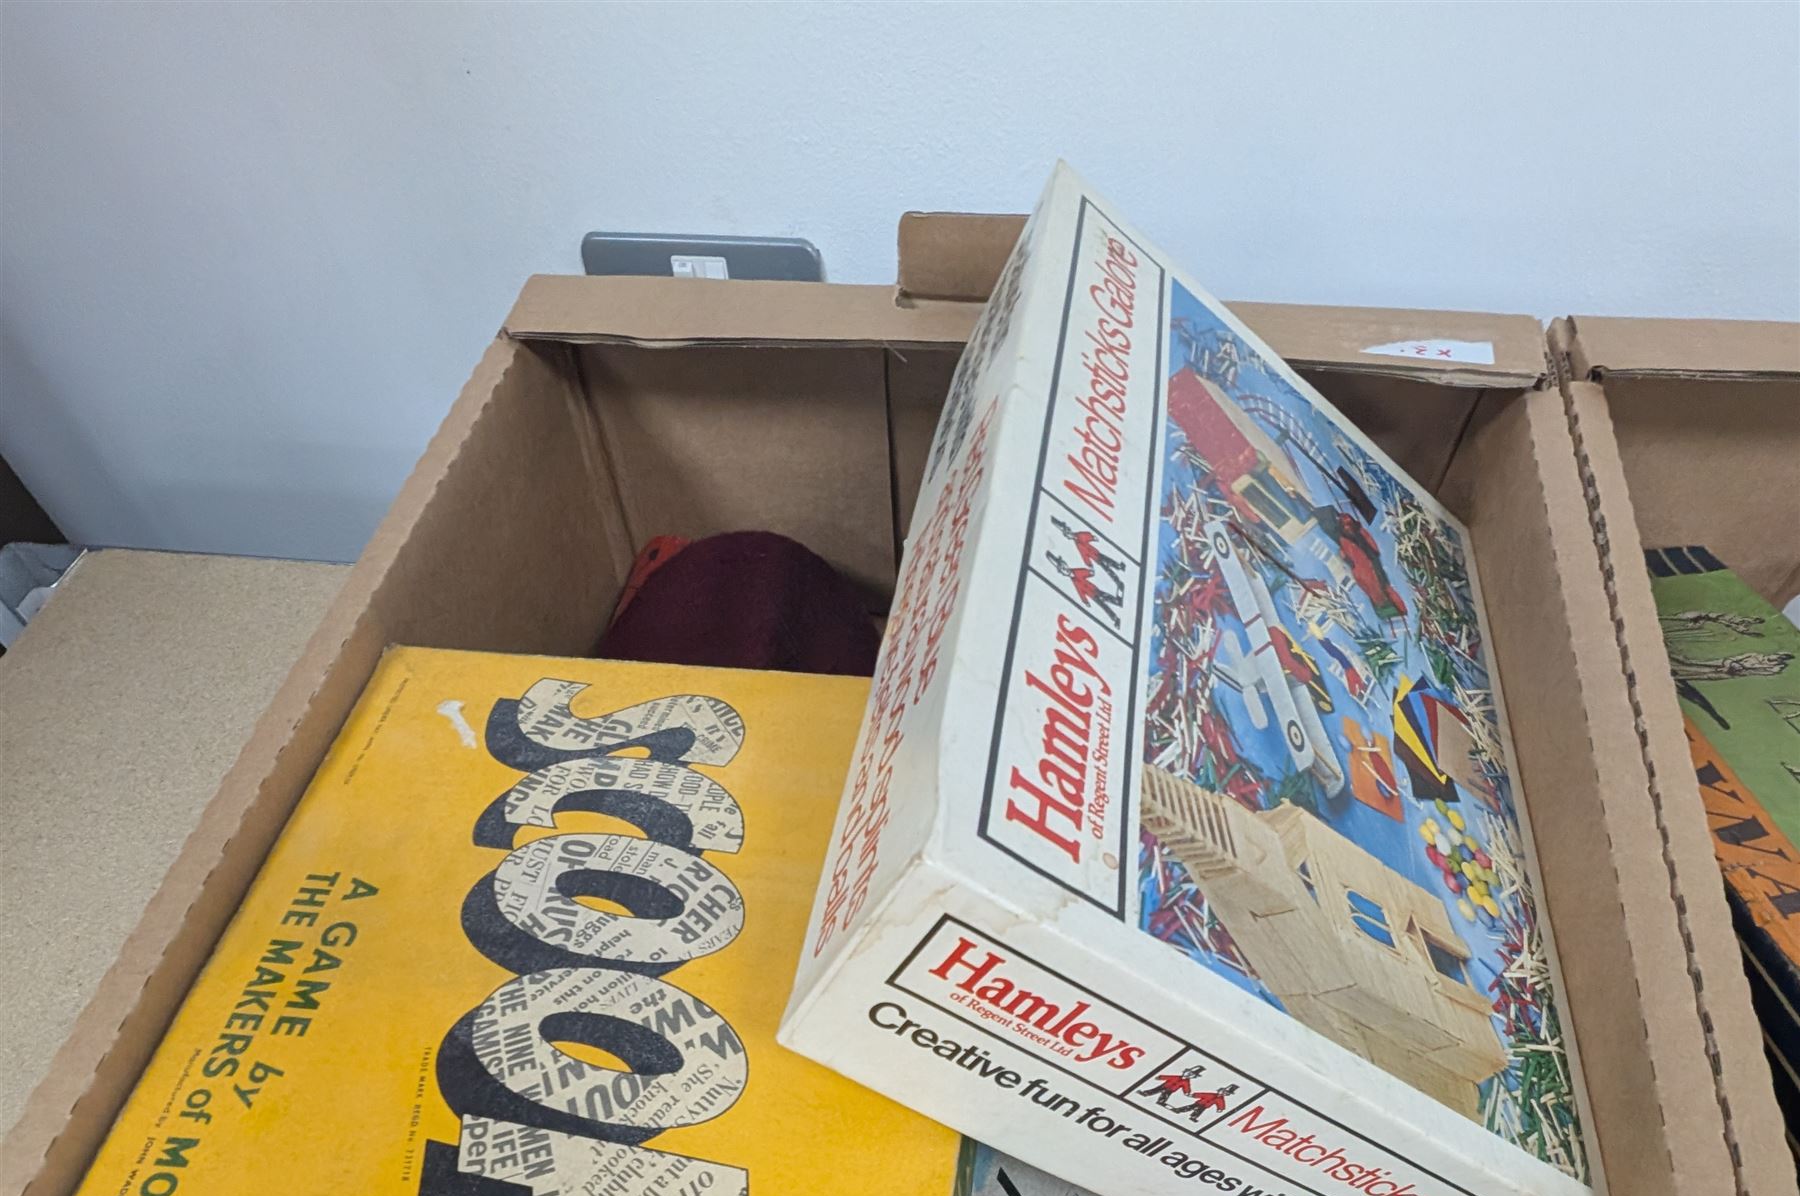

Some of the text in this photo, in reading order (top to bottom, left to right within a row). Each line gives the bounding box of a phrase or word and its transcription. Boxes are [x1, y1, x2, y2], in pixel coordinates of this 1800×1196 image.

[1064, 237, 1139, 523] Matchsticks Galore
[1005, 613, 1114, 865] Hamleys
[1089, 765, 1110, 821] Regent
[280, 871, 342, 928] THE
[202, 937, 305, 1079] MAKERS
[233, 876, 380, 1110] A GAME by
[552, 984, 583, 1006] this
[929, 937, 1146, 1070] Hamleys
[949, 989, 1074, 1058] of Regent Street Ltd
[502, 1022, 538, 1077] NINE
[179, 1087, 214, 1127] of
[416, 1075, 427, 1099] MARK
[868, 1001, 1022, 1089] Creative
[1019, 1078, 1084, 1119] fun
[1075, 1107, 1134, 1144] for
[1122, 1131, 1173, 1158] all
[1160, 1156, 1243, 1193] ages
[137, 1136, 157, 1166] JOHN
